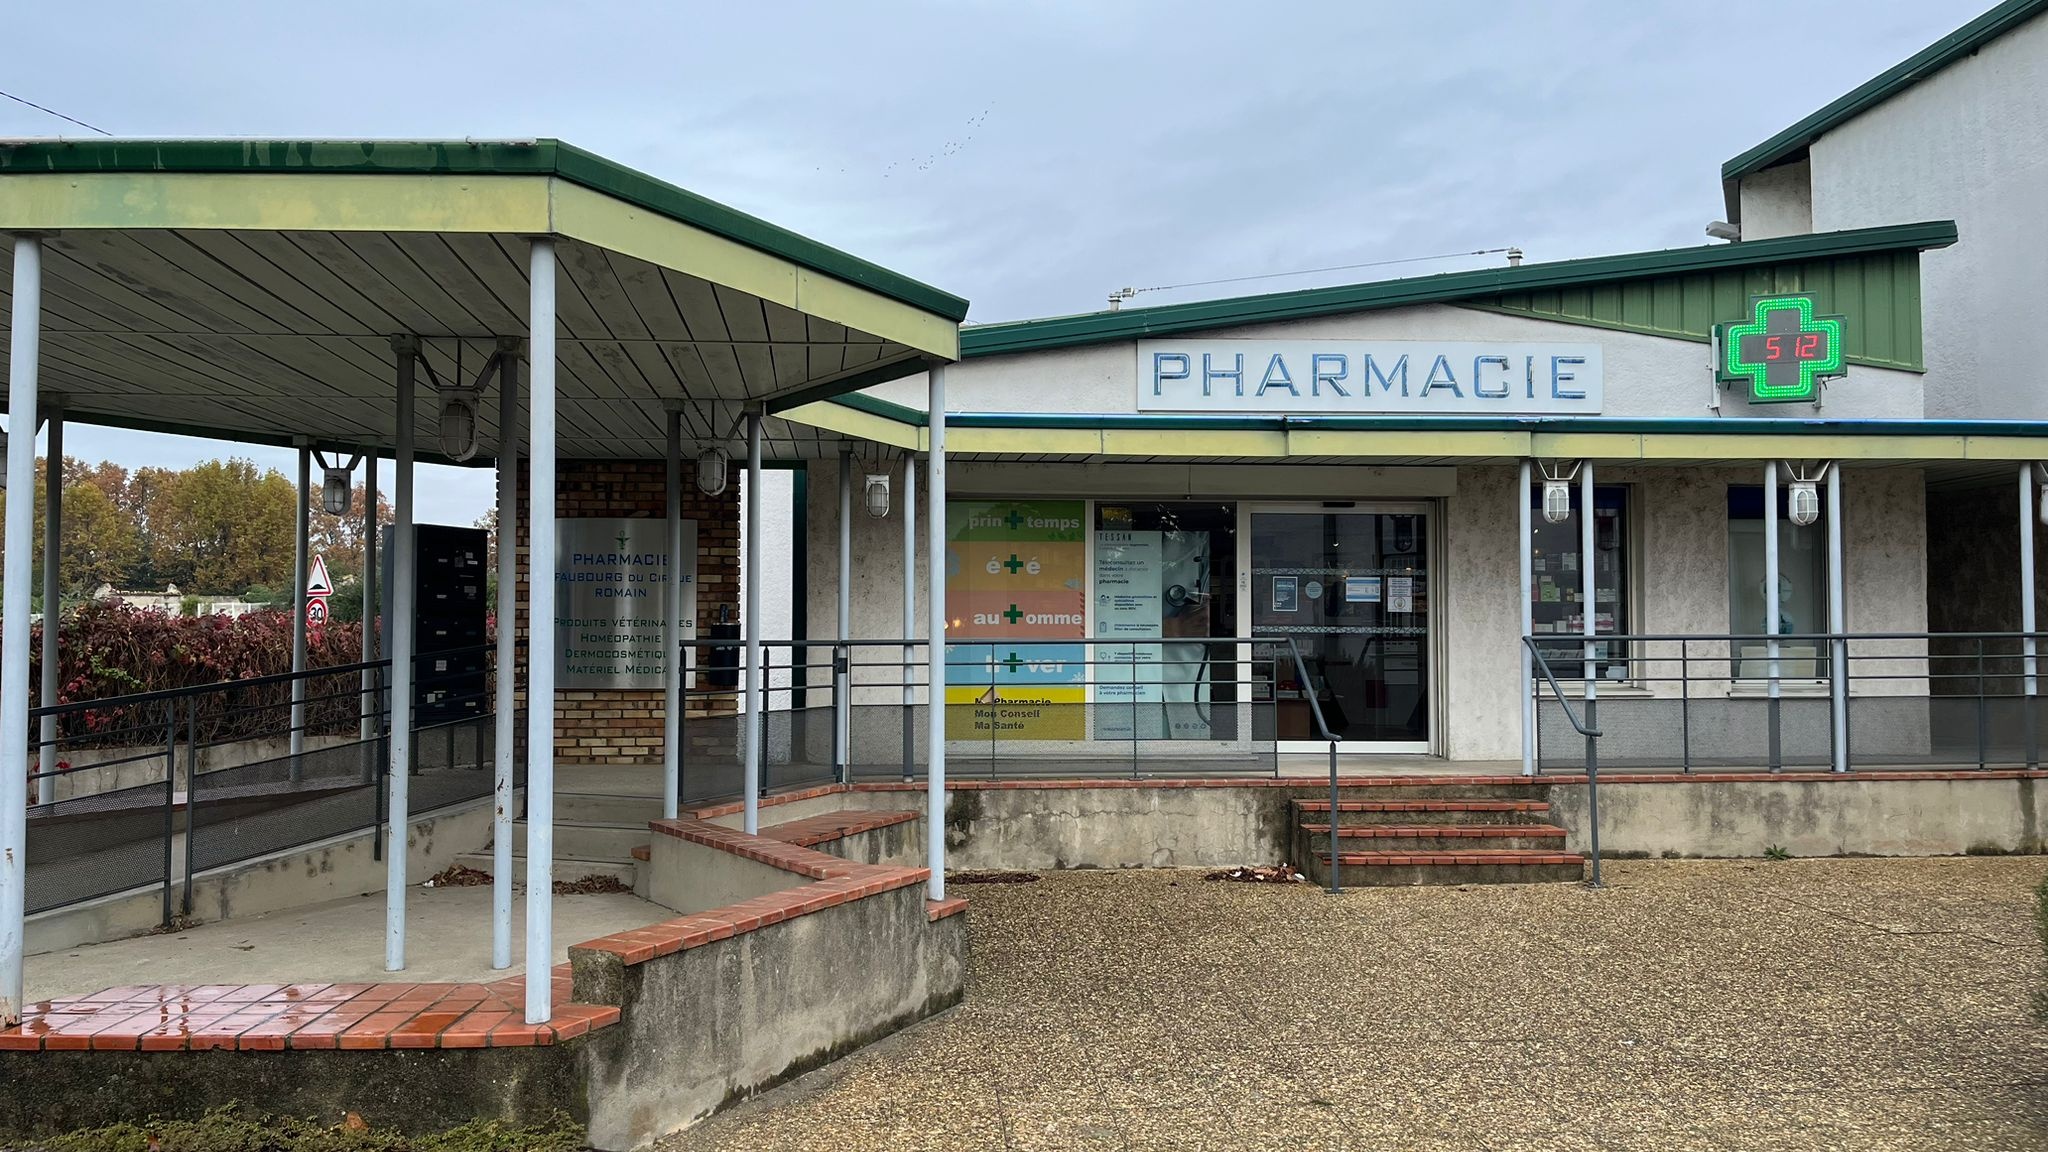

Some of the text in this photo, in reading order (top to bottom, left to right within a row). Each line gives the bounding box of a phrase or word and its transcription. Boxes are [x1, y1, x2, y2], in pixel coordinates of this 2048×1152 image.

[1765, 335, 1819, 360] 5 12
[1152, 351, 1588, 400] PHARMACIE
[1099, 533, 1132, 541] TESSAN
[573, 553, 668, 566] PHARMACIE
[594, 587, 647, 598] ROMAIN
[310, 606, 323, 620] 30
[611, 616, 693, 628] VÉTÉRINAES
[1000, 709, 1041, 719] Conseil
